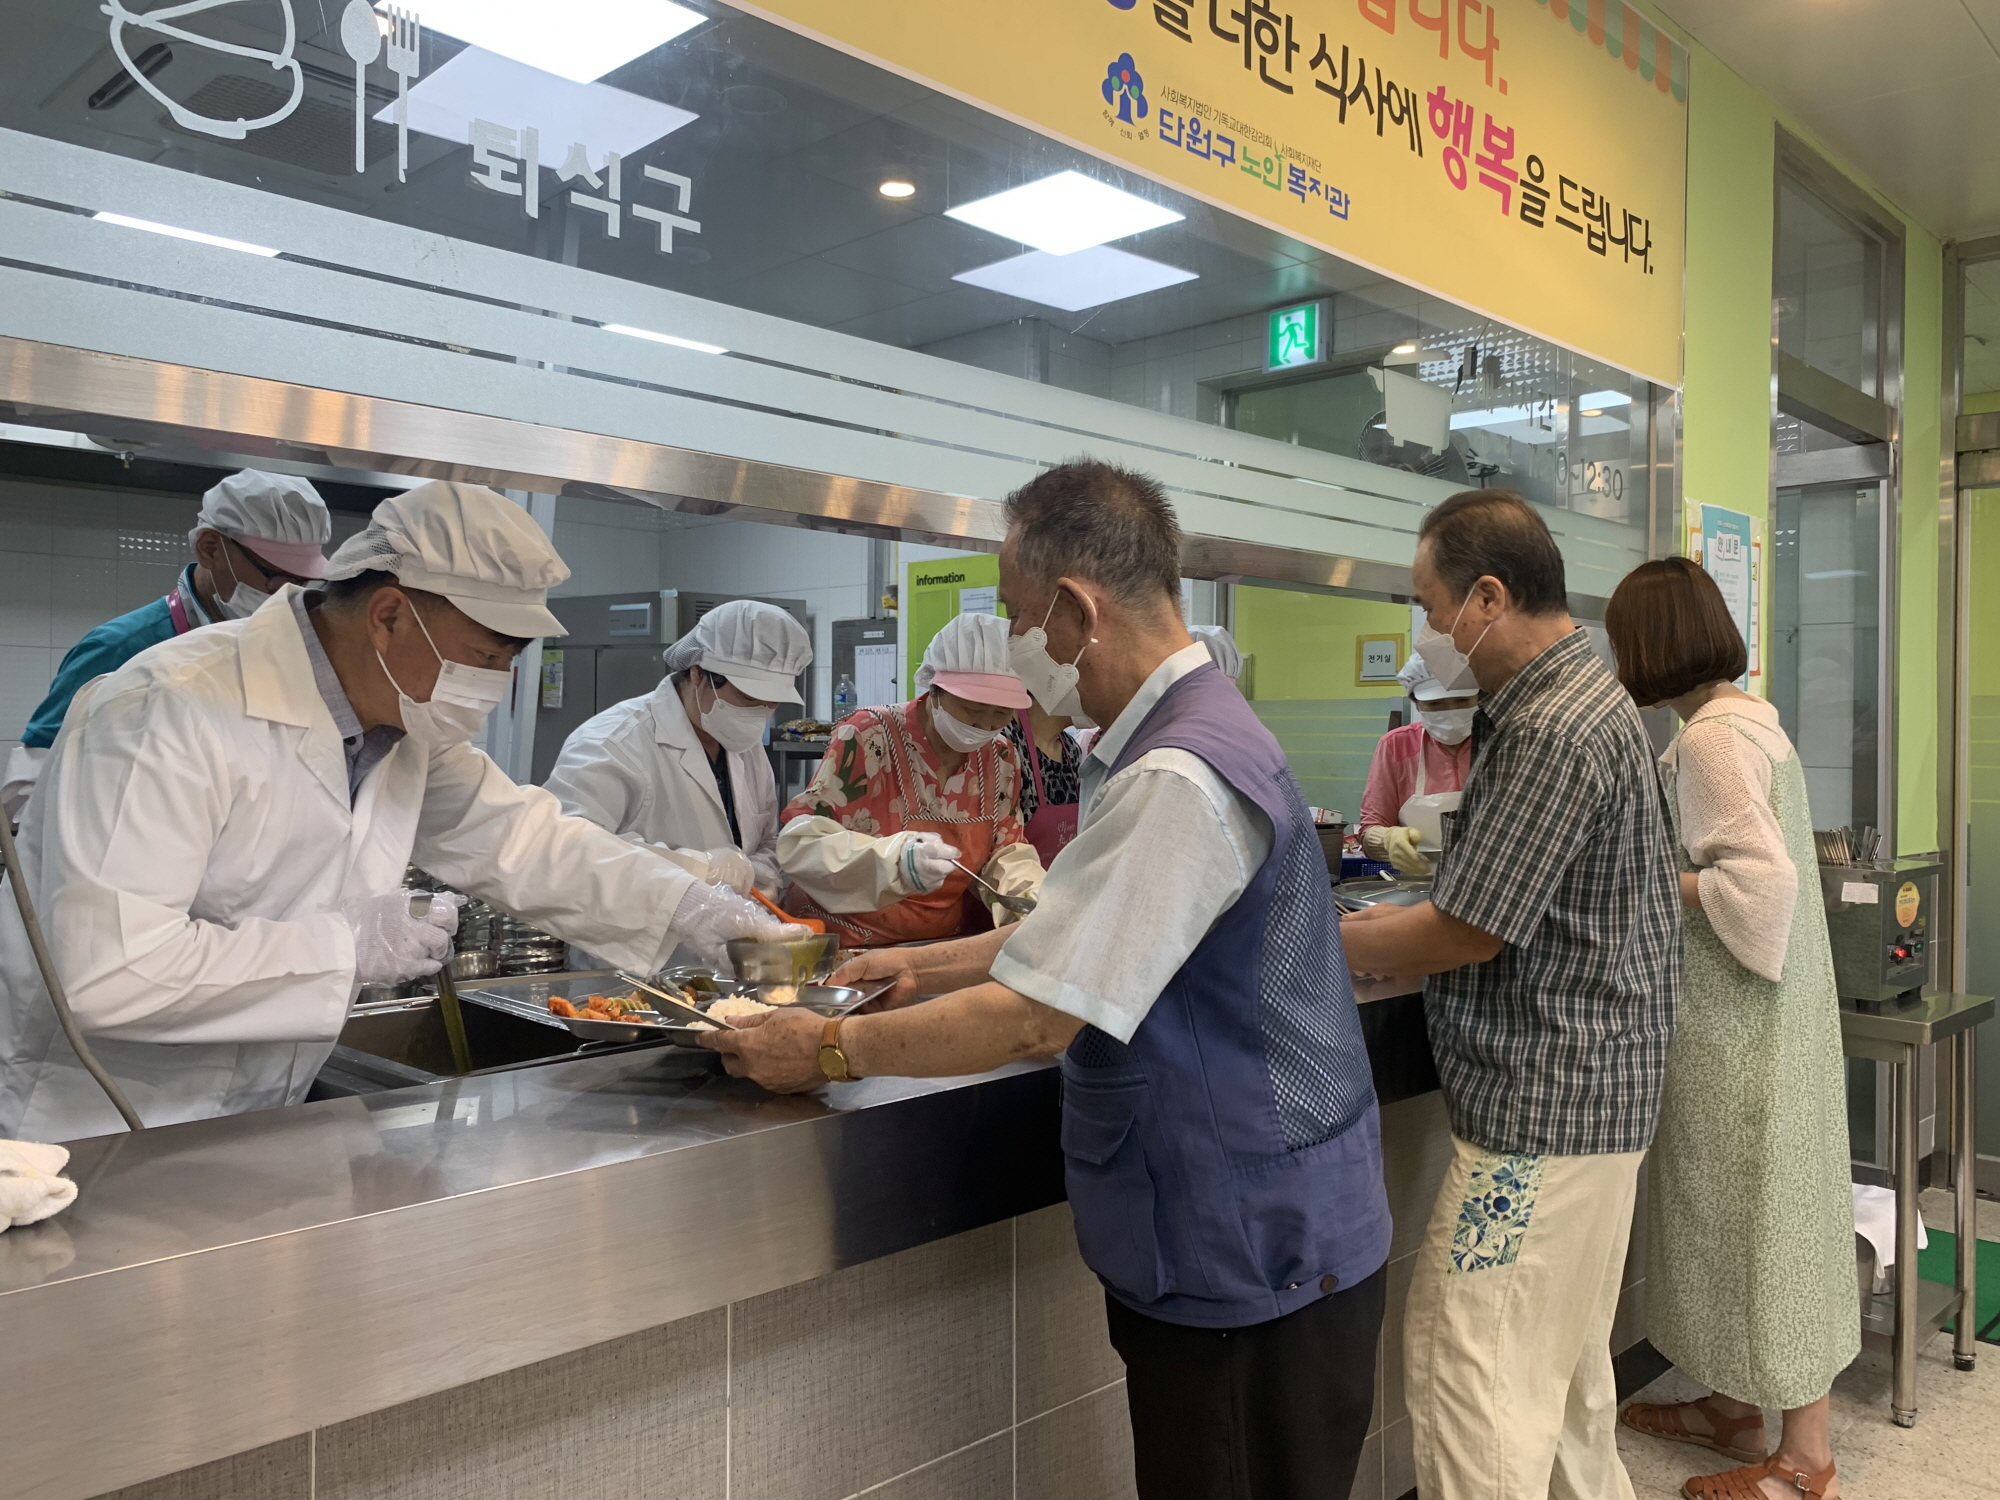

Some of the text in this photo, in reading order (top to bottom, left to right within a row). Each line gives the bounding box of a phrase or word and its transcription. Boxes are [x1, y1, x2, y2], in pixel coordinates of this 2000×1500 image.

[1161, 85, 1211, 120] 사회복지법인
[1213, 109, 1272, 149] 기독교대한감리회
[470, 118, 701, 254] 퇴식구
[1159, 108, 1350, 221] 단원구 노인 복지관
[1309, 33, 1423, 158] 식사에
[1427, 86, 1550, 228] 행복을
[1555, 174, 1653, 275] 드립니다.
[1717, 536, 1739, 556] 안내문
[916, 571, 965, 586] information
[1368, 654, 1391, 663] 전기실
